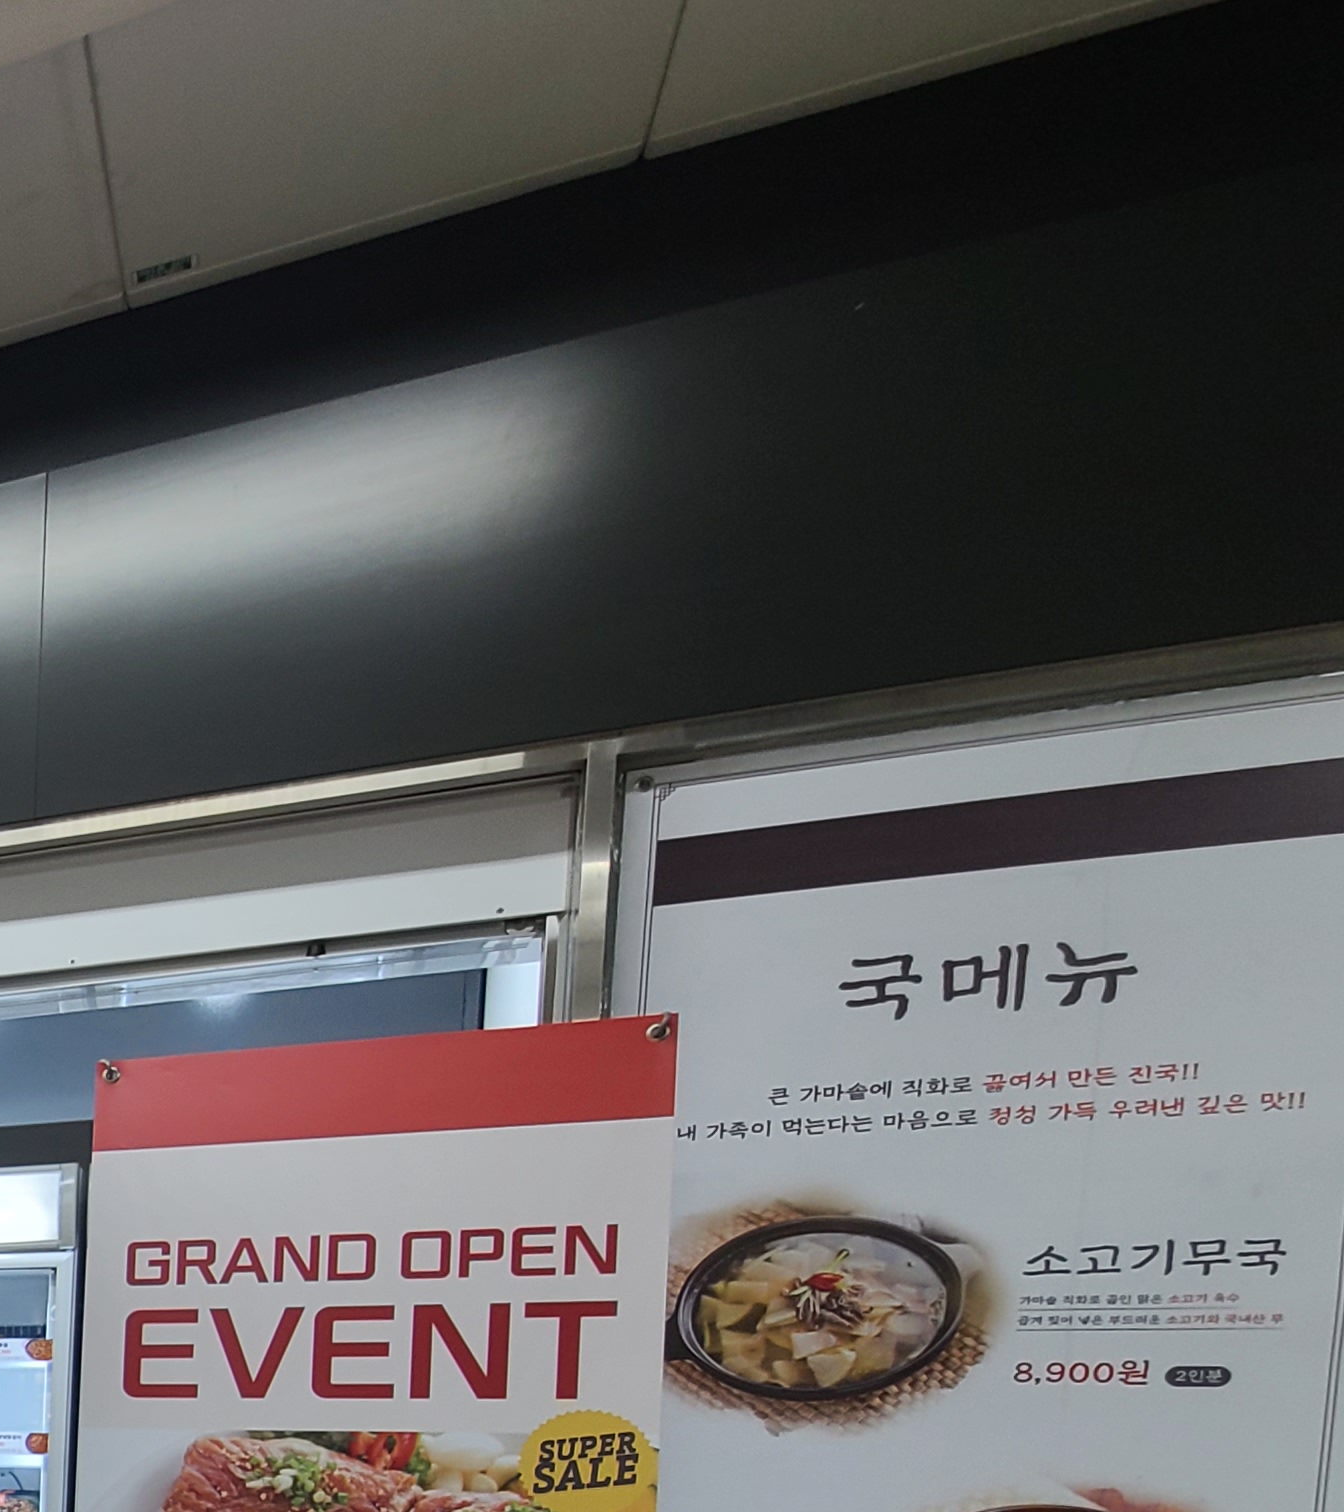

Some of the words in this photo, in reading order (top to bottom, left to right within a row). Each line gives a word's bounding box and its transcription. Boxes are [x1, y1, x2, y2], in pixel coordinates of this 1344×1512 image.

[838, 941, 1137, 1021] 국메뉴
[768, 1086, 790, 1105] 큰
[799, 1080, 893, 1104] 가마솥에
[902, 1075, 973, 1098] 직화로
[981, 1070, 1057, 1094] 끓여서
[1067, 1066, 1118, 1089] 만든
[1128, 1062, 1201, 1085] 진국!!
[676, 1125, 697, 1142] 내
[706, 1119, 772, 1140] 가족이
[782, 1113, 873, 1137] 먹는다는
[883, 1107, 978, 1131] 마음으로
[988, 1104, 1038, 1128] 정성
[1049, 1101, 1097, 1123] 가득
[1108, 1097, 1187, 1119] 우려낸
[1198, 1094, 1249, 1117] 깊은
[1261, 1091, 1306, 1114] 맛!!
[125, 1233, 377, 1287] GRAND
[400, 1224, 619, 1279] OPEN
[1022, 1239, 1287, 1276] 소고기무국
[1168, 1293, 1208, 1304] 소고기
[1108, 1315, 1161, 1326] 부드러운
[122, 1301, 618, 1400] EVENT
[1013, 1359, 1150, 1385] 8,900원
[1174, 1370, 1224, 1383] 2인분
[538, 1432, 637, 1462] SUPER
[532, 1452, 640, 1494] SALE
